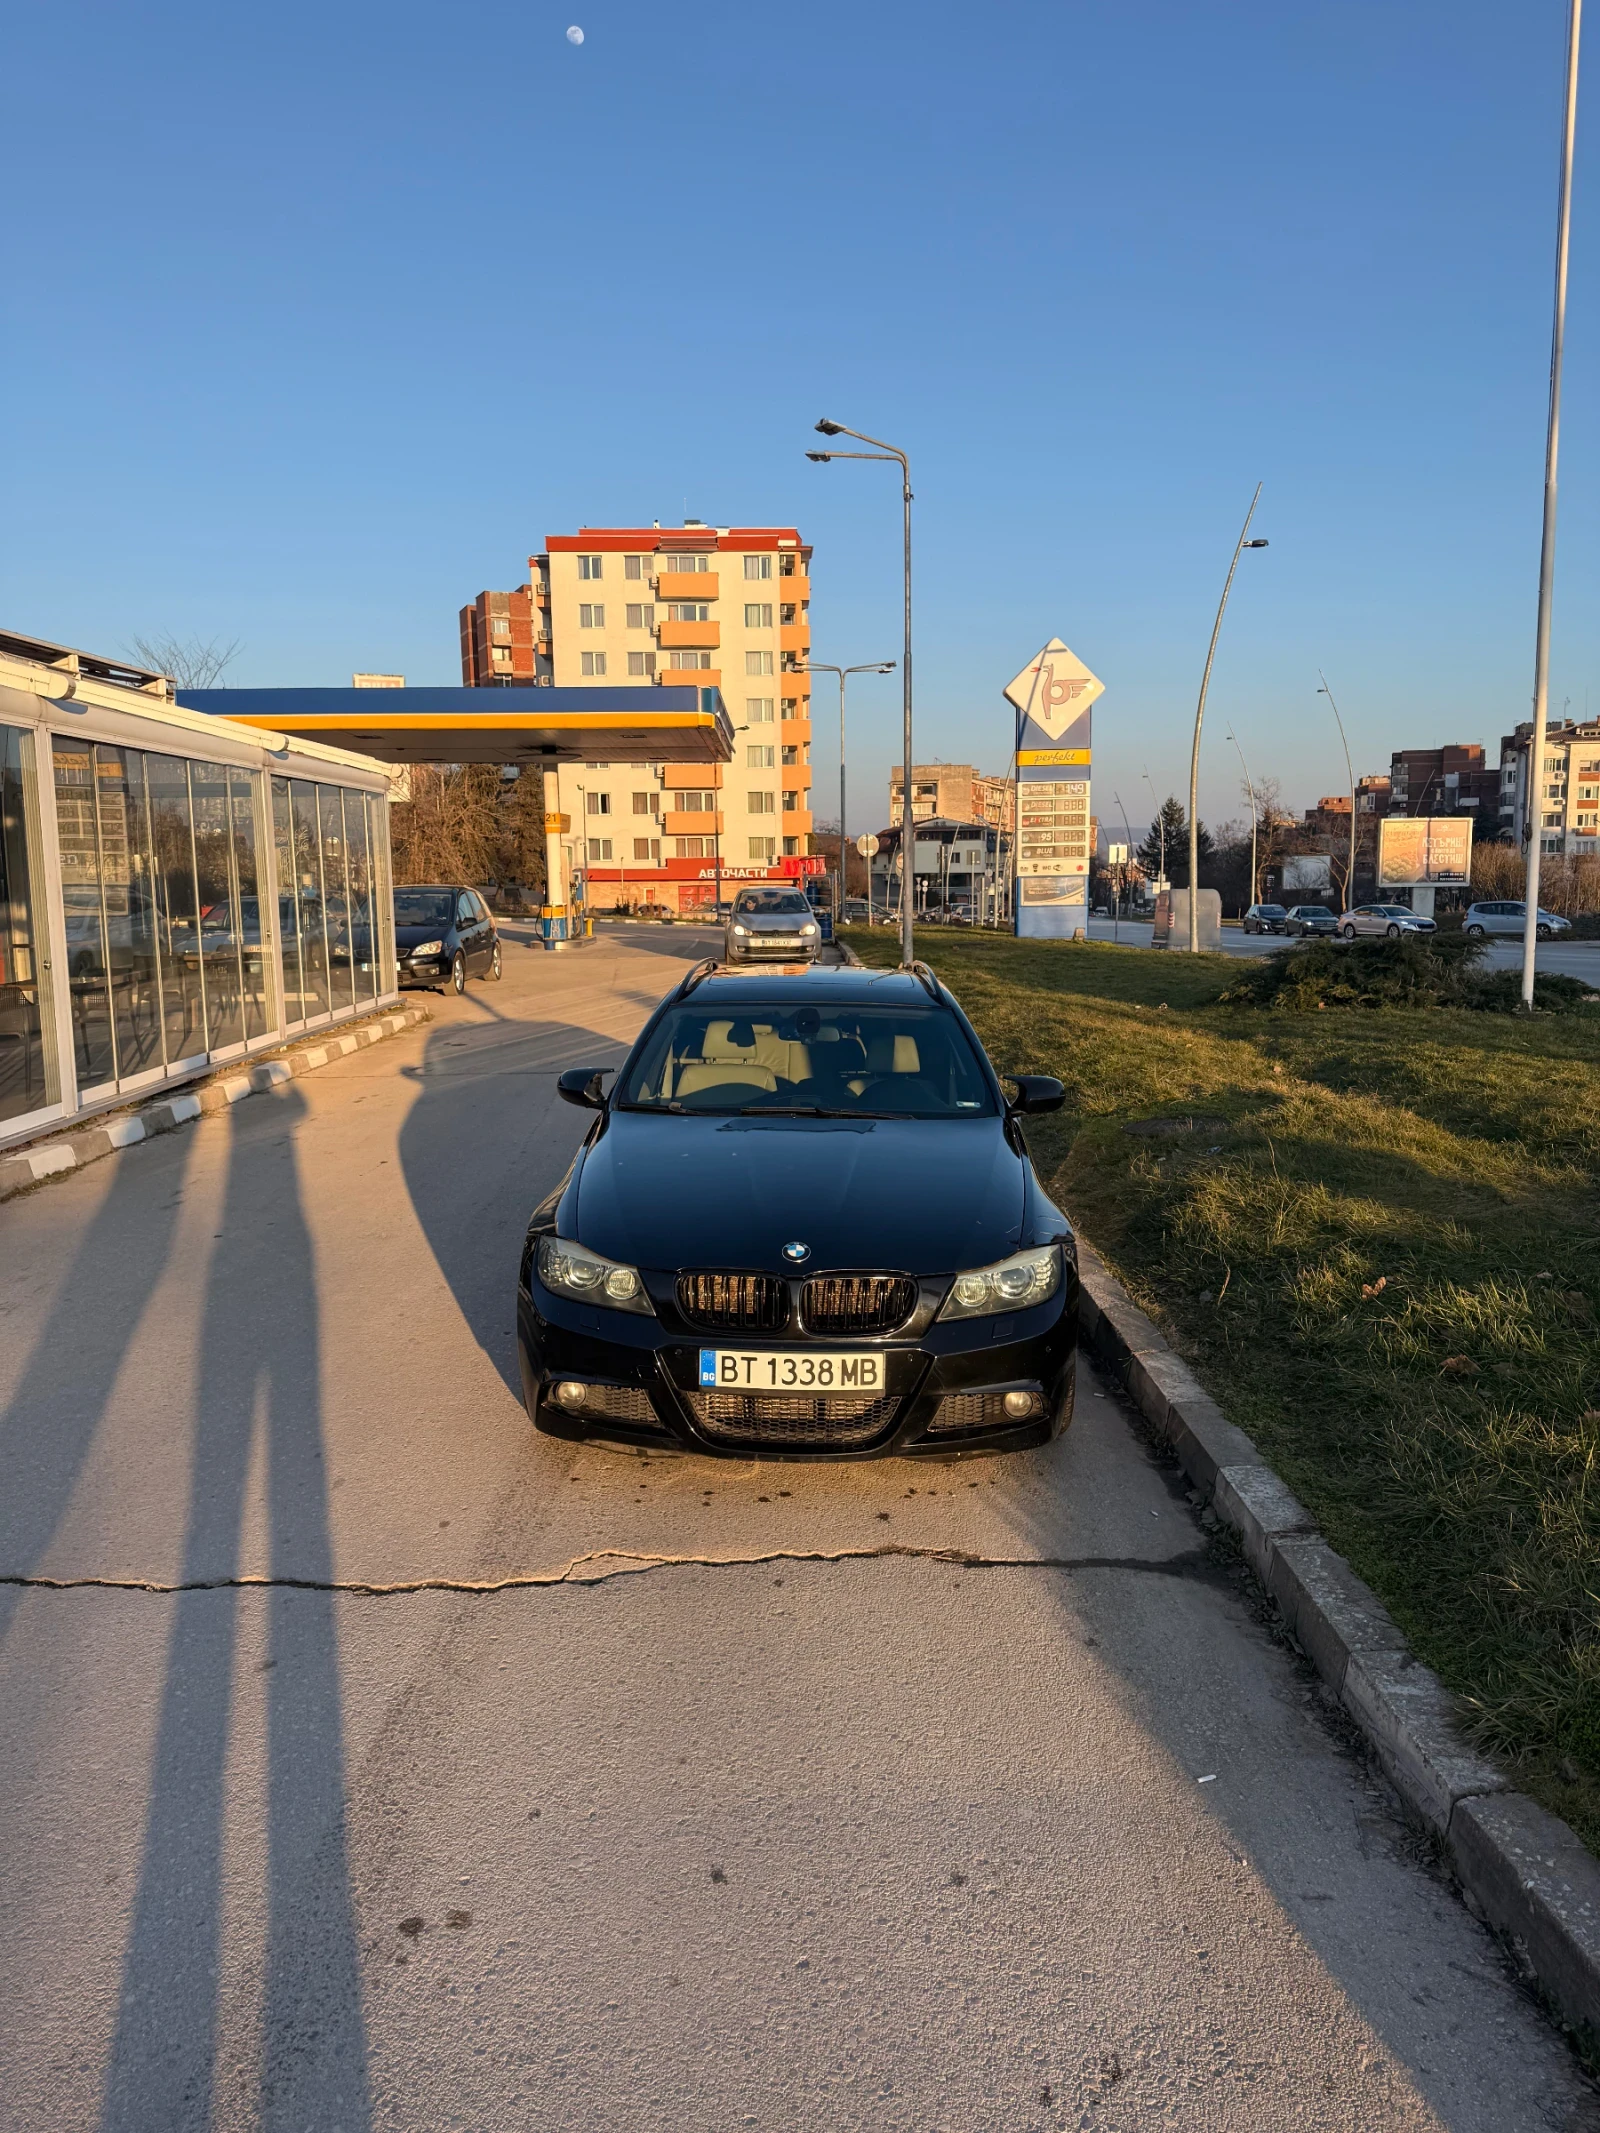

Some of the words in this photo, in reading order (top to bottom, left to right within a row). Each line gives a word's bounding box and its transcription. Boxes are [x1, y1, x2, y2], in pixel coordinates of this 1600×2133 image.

[1034, 751, 1075, 764] perfekt
[545, 813, 556, 822] 21
[1040, 833, 1052, 841] 95
[699, 868, 768, 878] АВОЧАСТИ
[721, 1355, 758, 1384] BT
[767, 1357, 834, 1386] 1338
[840, 1358, 877, 1386] MB
[702, 1372, 716, 1381] BG
